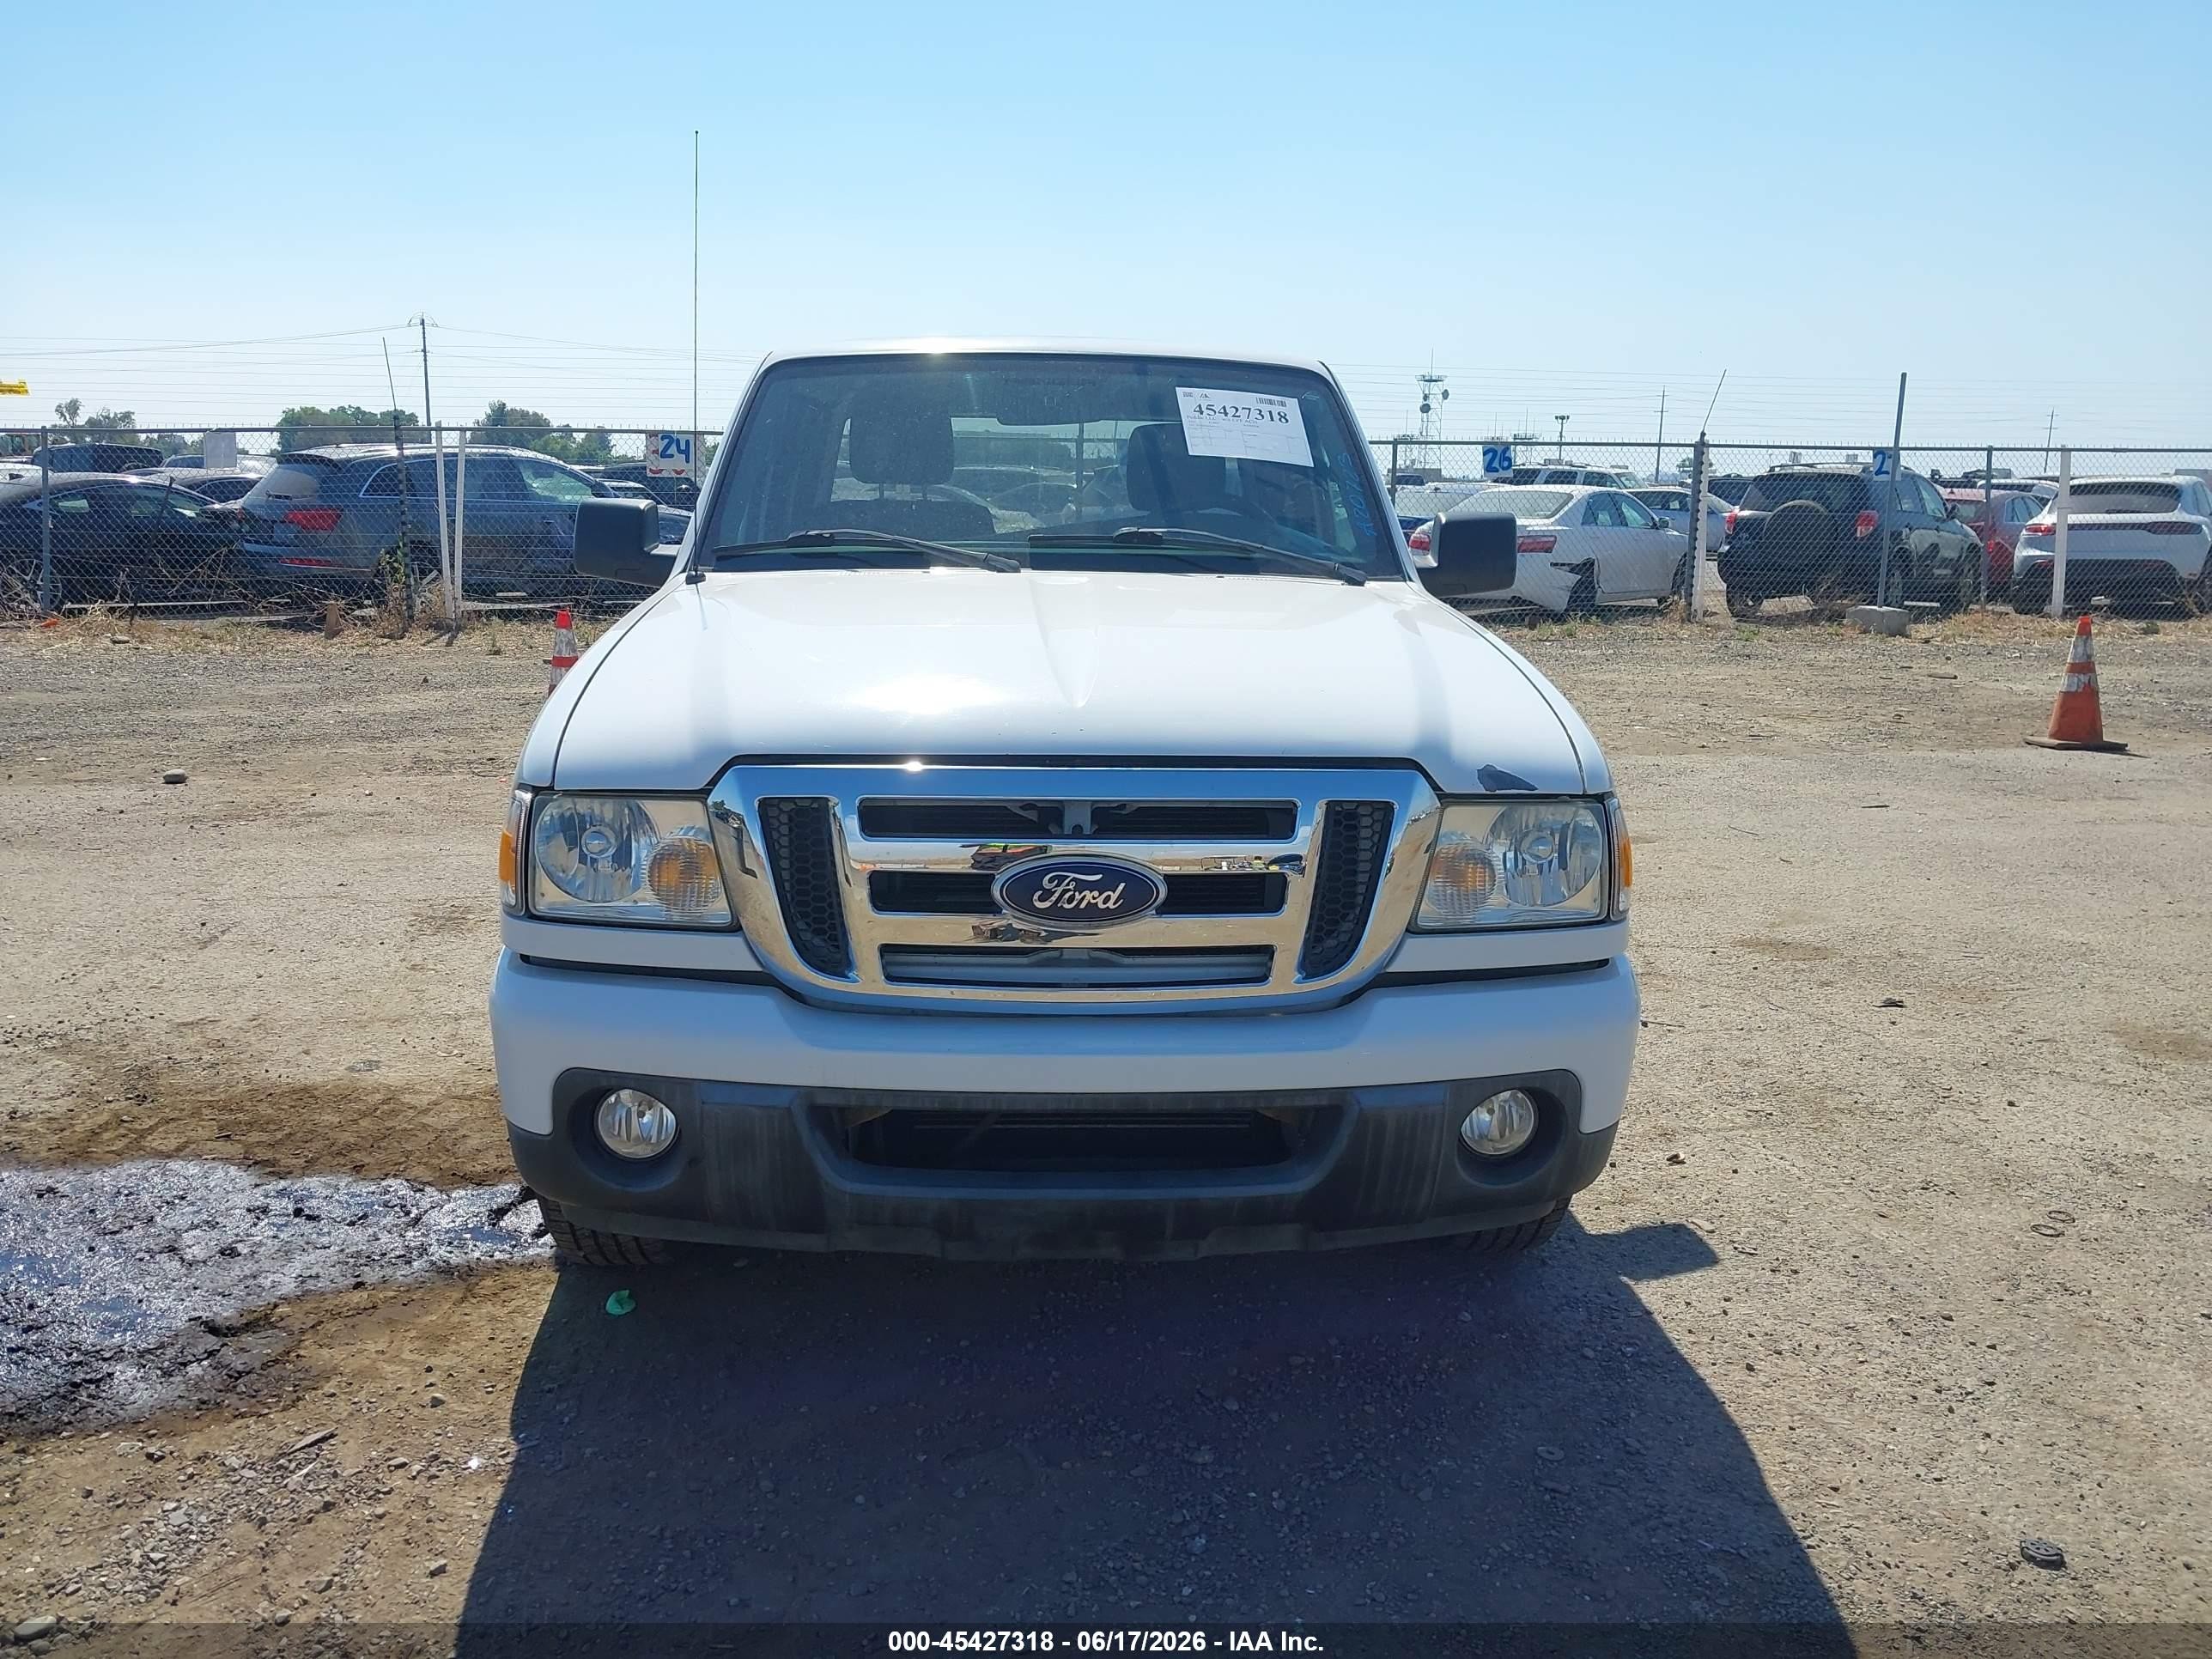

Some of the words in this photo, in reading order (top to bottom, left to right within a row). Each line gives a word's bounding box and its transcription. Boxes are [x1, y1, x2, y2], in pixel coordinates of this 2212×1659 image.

[1193, 404, 1289, 424] 45427318
[660, 434, 690, 464] 24
[1483, 447, 1512, 472] 26
[1032, 872, 1126, 908] Ford
